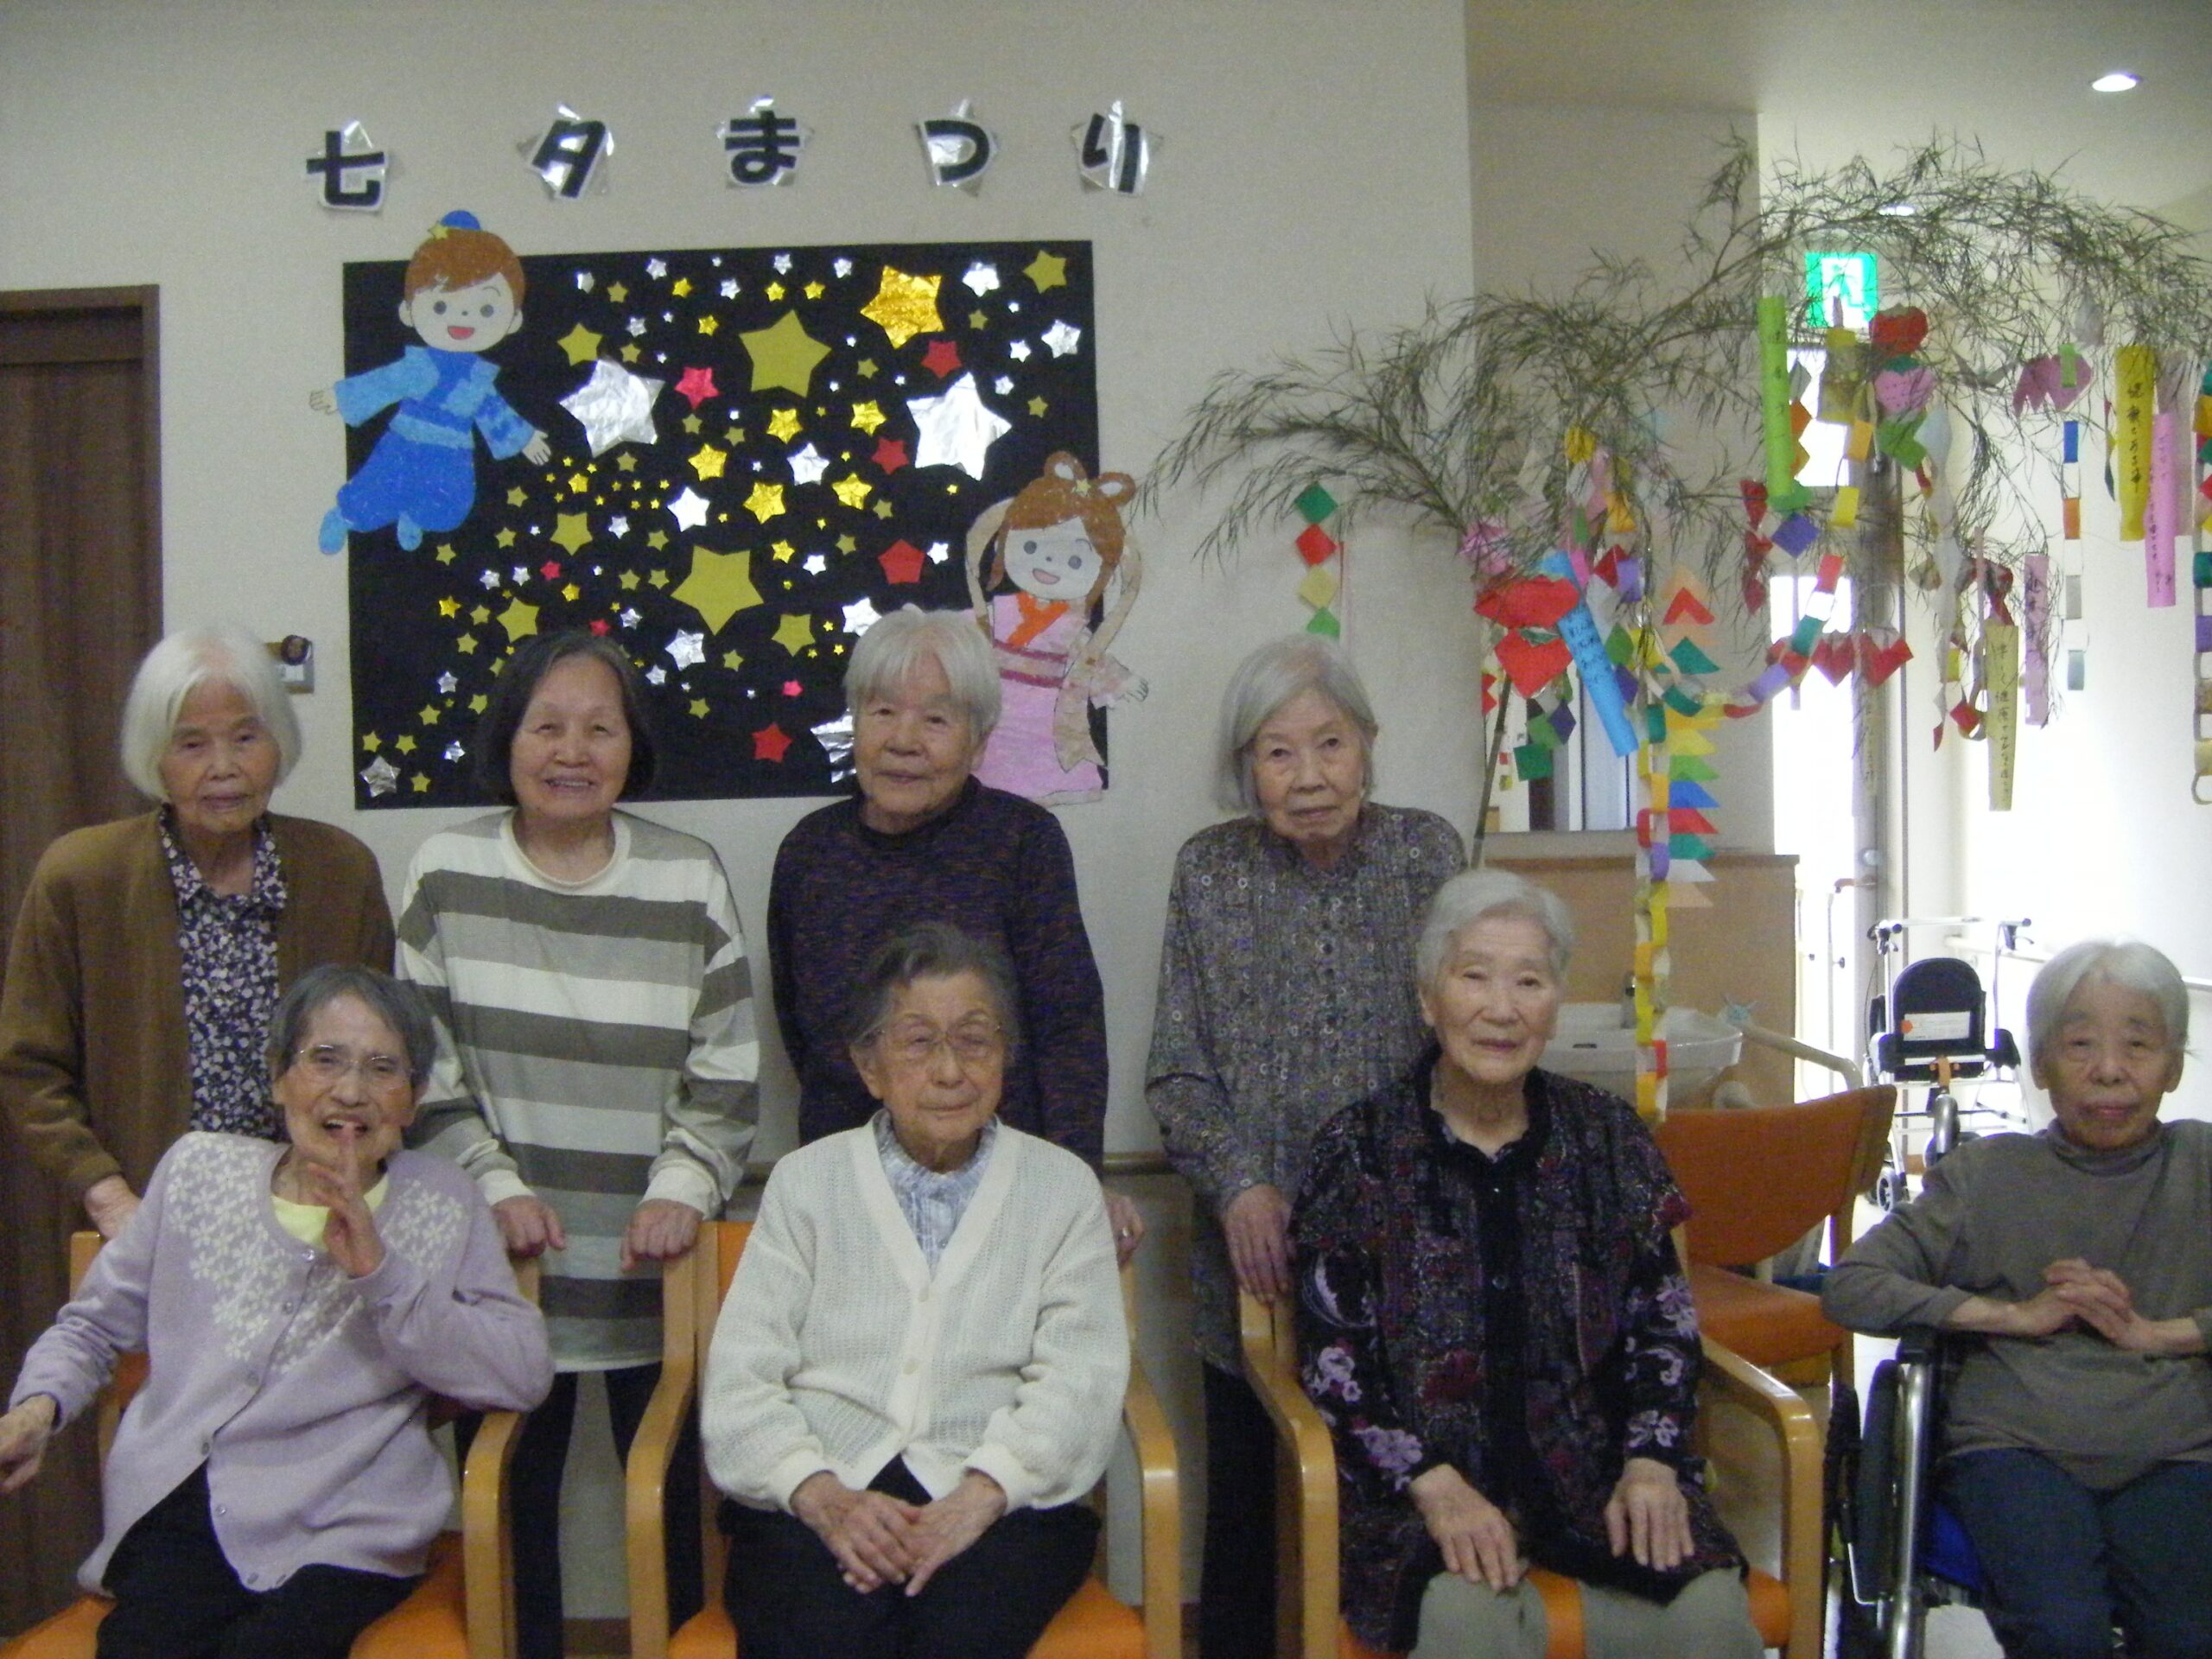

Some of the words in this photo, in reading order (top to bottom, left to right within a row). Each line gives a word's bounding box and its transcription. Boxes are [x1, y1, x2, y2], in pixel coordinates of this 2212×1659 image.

[306, 110, 1141, 206] 七夕まつり
